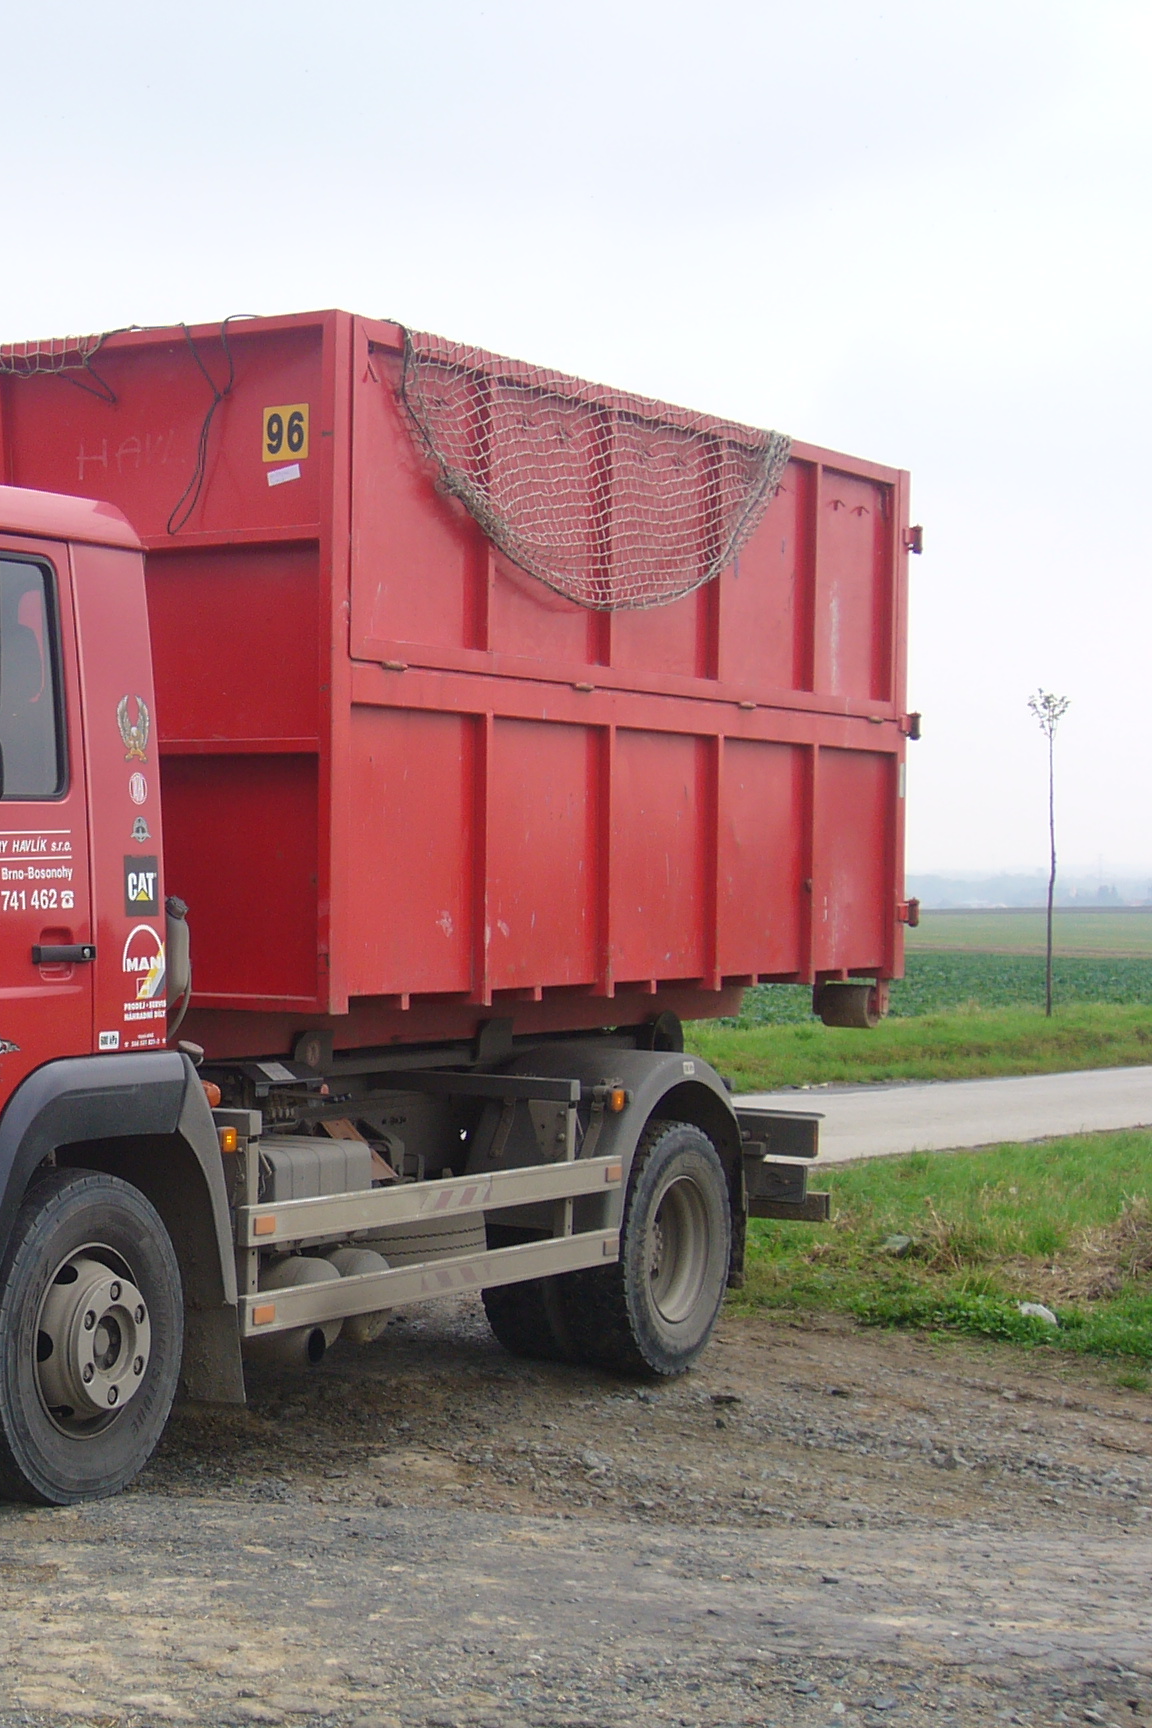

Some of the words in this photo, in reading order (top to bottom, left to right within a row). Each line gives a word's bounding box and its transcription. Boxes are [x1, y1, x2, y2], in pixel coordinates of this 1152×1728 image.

[267, 411, 304, 454] 96
[12, 836, 48, 853] HAVLÍK
[51, 841, 72, 852] s.r.o.
[1, 865, 73, 881] Brno-Bosonohy
[128, 872, 154, 901] CAT
[1, 890, 26, 911] 741
[31, 888, 58, 909] 462
[127, 956, 164, 972] MAN
